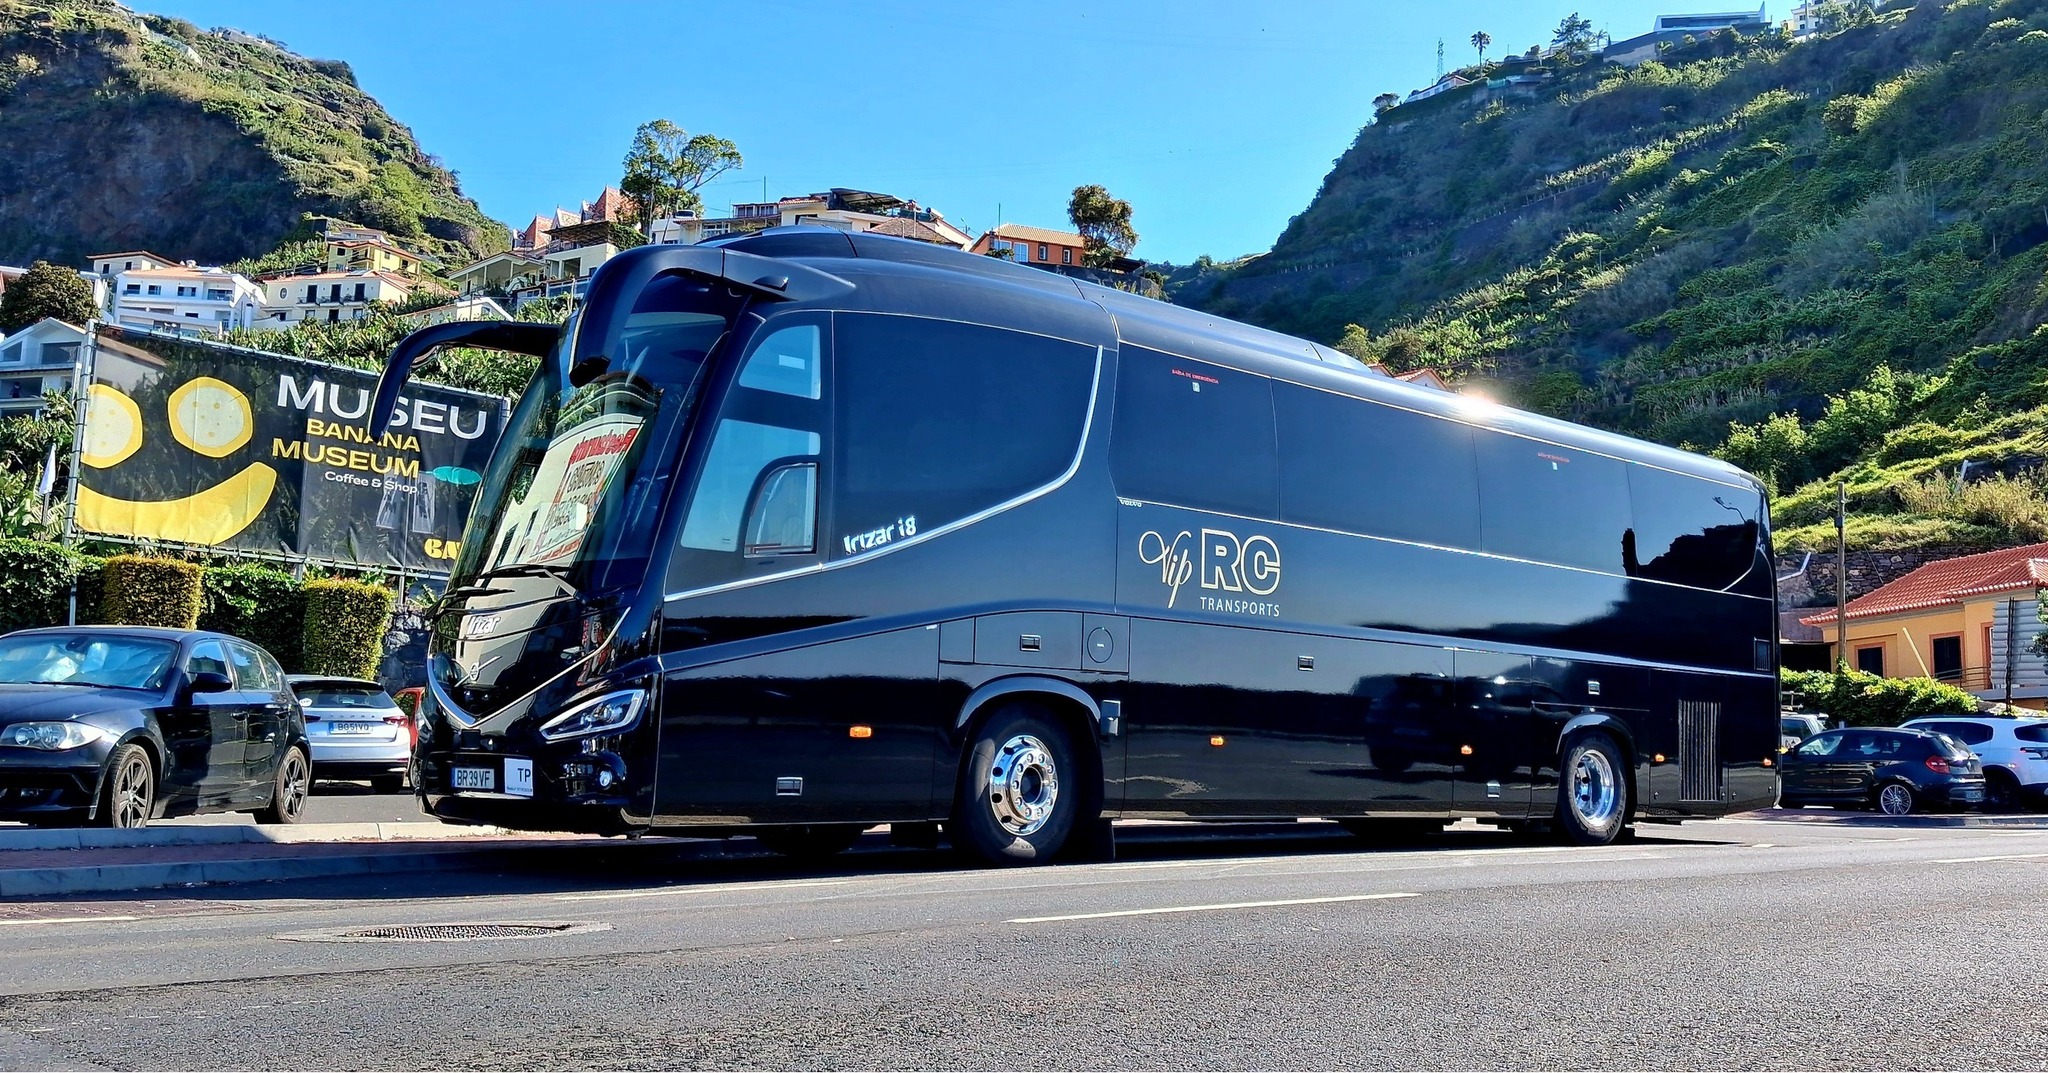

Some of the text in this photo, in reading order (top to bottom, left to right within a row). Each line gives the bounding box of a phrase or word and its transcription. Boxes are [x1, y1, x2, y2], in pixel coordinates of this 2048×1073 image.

[277, 374, 487, 440] MUSEU
[272, 437, 421, 479] MUSEUM
[324, 470, 418, 494] Coffee & Shop
[843, 515, 917, 554] Irizar i8
[1138, 528, 1281, 609] Vip RC
[1200, 596, 1280, 617] TRANSPORTS
[517, 767, 531, 783] TP
